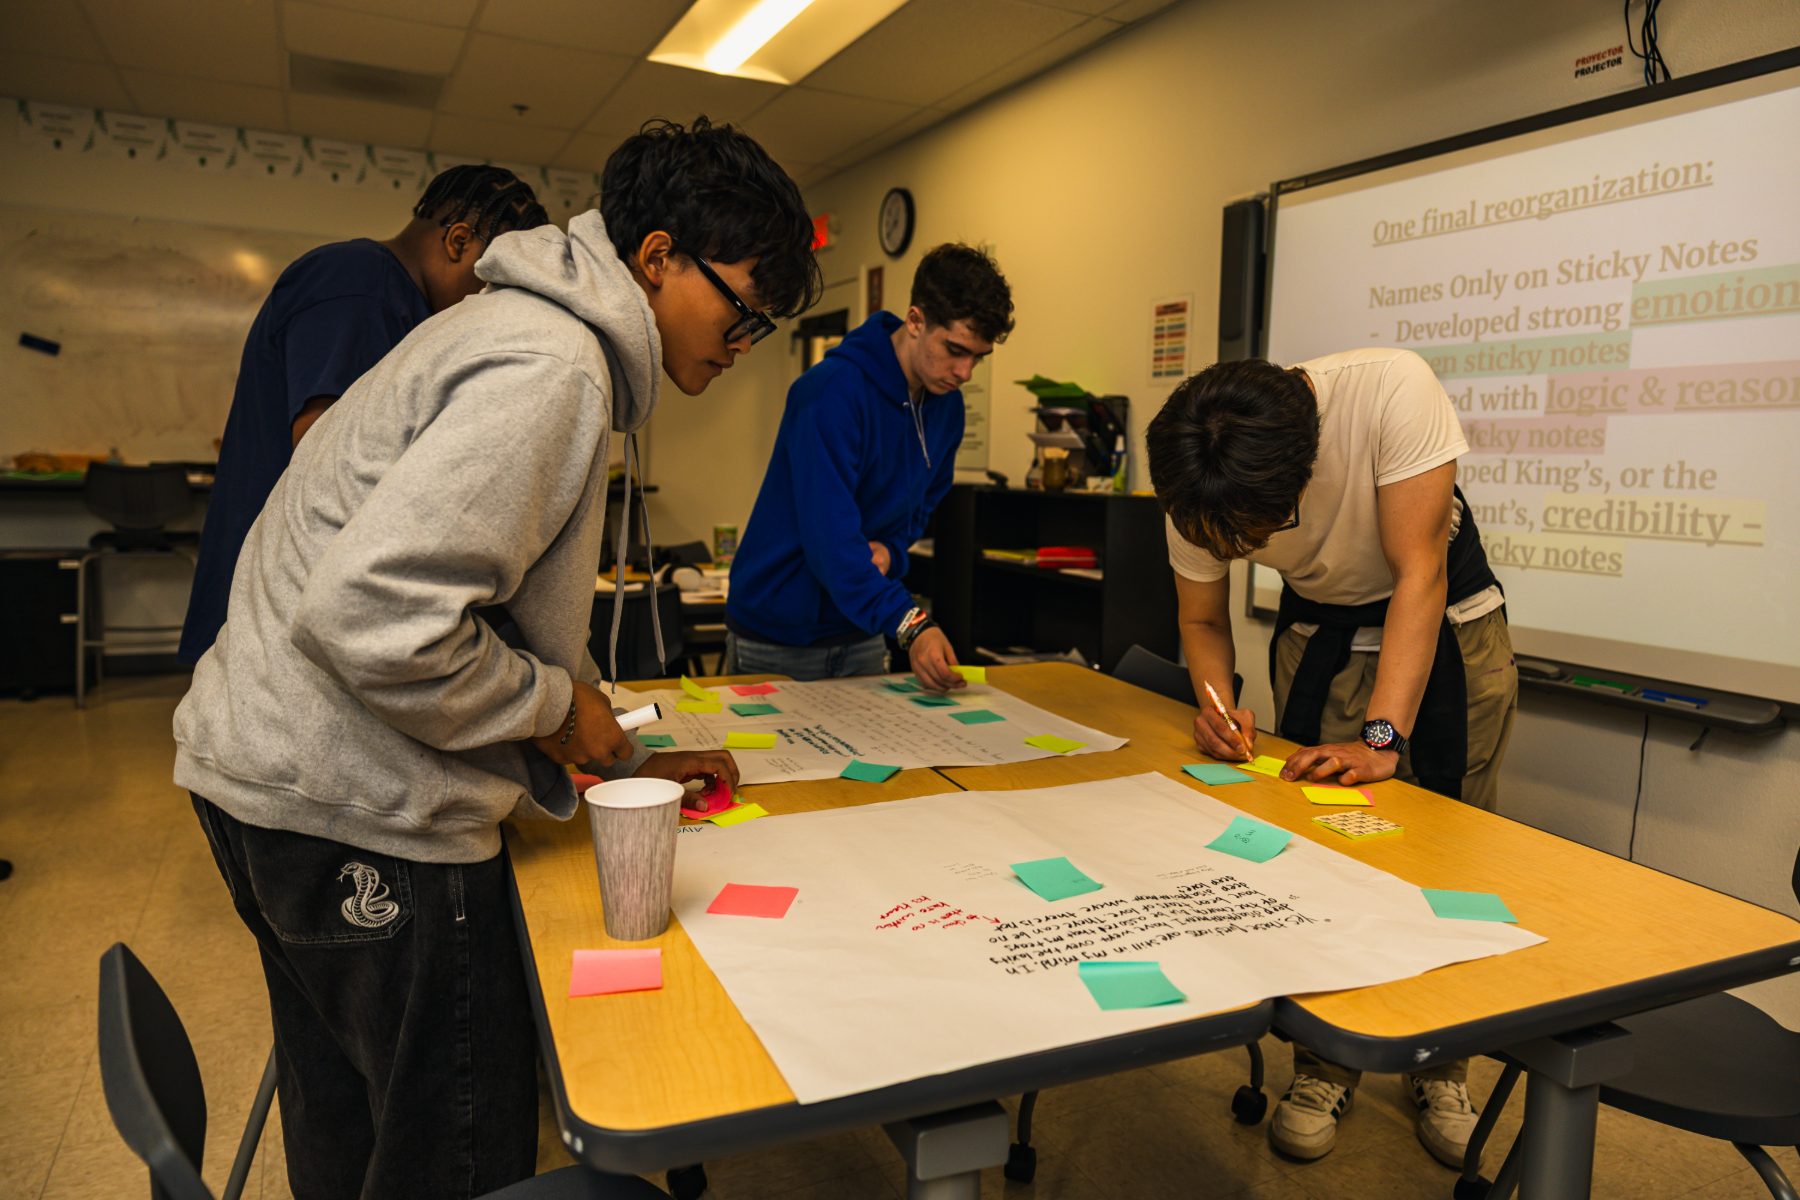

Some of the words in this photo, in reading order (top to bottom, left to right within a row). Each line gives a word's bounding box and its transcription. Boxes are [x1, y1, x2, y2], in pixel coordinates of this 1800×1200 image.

[1575, 45, 1624, 68] PROYECTOR
[1574, 57, 1623, 79] PROJECTOR
[1373, 219, 1416, 243] One
[1421, 200, 1477, 235] final
[1483, 160, 1714, 223] reorganization:
[1368, 283, 1444, 309] Names
[1450, 268, 1509, 301] Only
[1514, 268, 1549, 291] on
[1556, 250, 1651, 284] Sticky
[1658, 237, 1759, 273] Notes
[1395, 305, 1521, 343] Developed
[1527, 297, 1624, 332] strong
[1463, 343, 1543, 376] sticky
[1548, 339, 1630, 368] notes
[1480, 383, 1538, 412] with
[1545, 378, 1629, 416] logic
[1638, 376, 1667, 407] &
[1528, 424, 1606, 449] notes
[1515, 459, 1612, 495] King's,
[1620, 466, 1655, 489] or
[1663, 460, 1719, 490] the
[1541, 499, 1732, 548] credibility
[1543, 543, 1624, 574] notes
[1080, 899, 1129, 914] where
[1033, 911, 1078, 925] there
[1067, 915, 1107, 929] There
[994, 921, 1019, 932] not
[1031, 924, 1062, 936] can
[1134, 920, 1172, 933] have
[988, 934, 1009, 945] no
[1011, 931, 1031, 941] be
[1003, 940, 1046, 952] tears
[1033, 946, 1061, 957] the
[1065, 939, 1095, 950] over
[1113, 945, 1129, 954] in
[1131, 937, 1161, 952] still
[989, 952, 1034, 966] laxity
[1081, 949, 1108, 961] my
[1006, 964, 1036, 977] In
